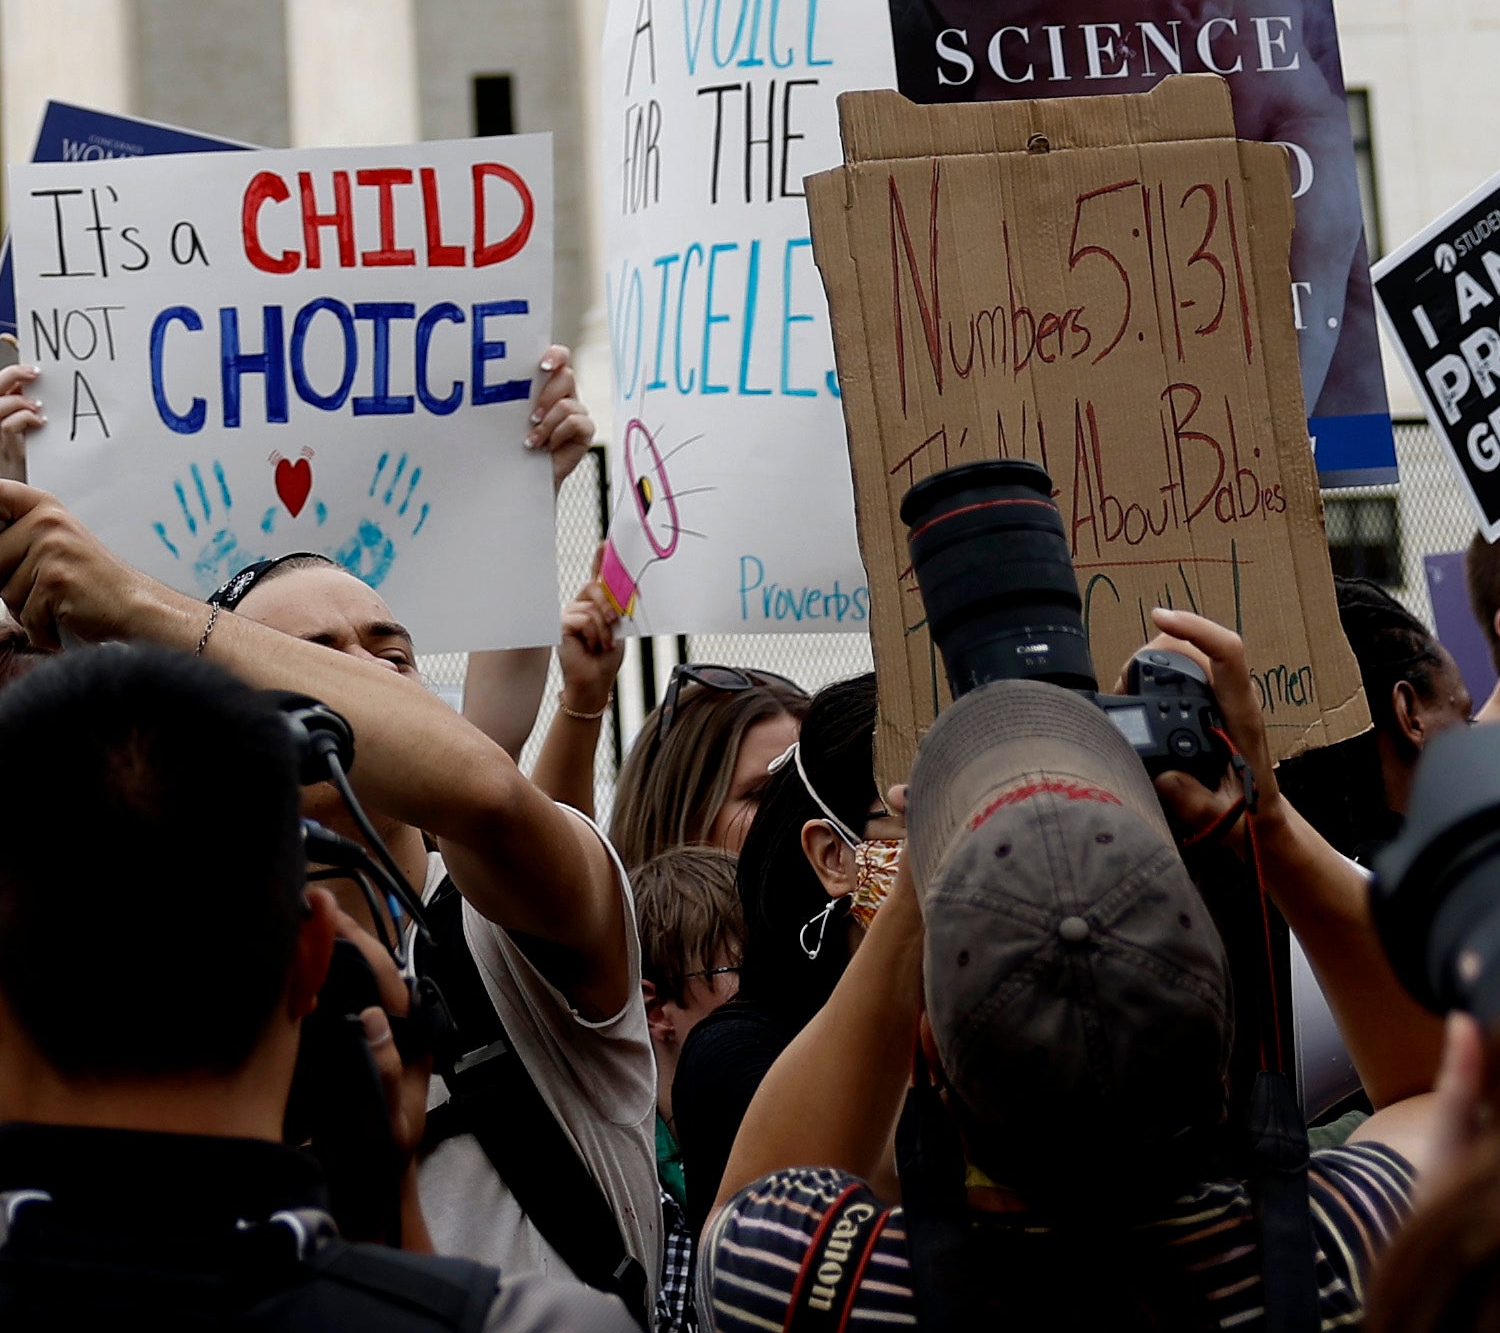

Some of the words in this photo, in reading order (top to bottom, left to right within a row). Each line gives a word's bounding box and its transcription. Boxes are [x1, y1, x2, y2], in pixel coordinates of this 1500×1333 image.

[934, 15, 1300, 86] SCIENCE
[622, 99, 662, 215] FOR
[697, 79, 820, 205] THE
[31, 184, 150, 279] It's
[169, 219, 209, 267] a
[242, 161, 535, 275] CHILD
[605, 237, 842, 400] VOICELE
[887, 158, 1092, 417] Numbers
[1412, 303, 1441, 350] I
[31, 305, 126, 362] NOT
[149, 298, 532, 435] CHOICE
[69, 370, 110, 442] A
[1071, 397, 1180, 559] About
[1160, 382, 1287, 527] Babies
[739, 553, 869, 622] Proverbs
[808, 1203, 875, 1312] Canon
